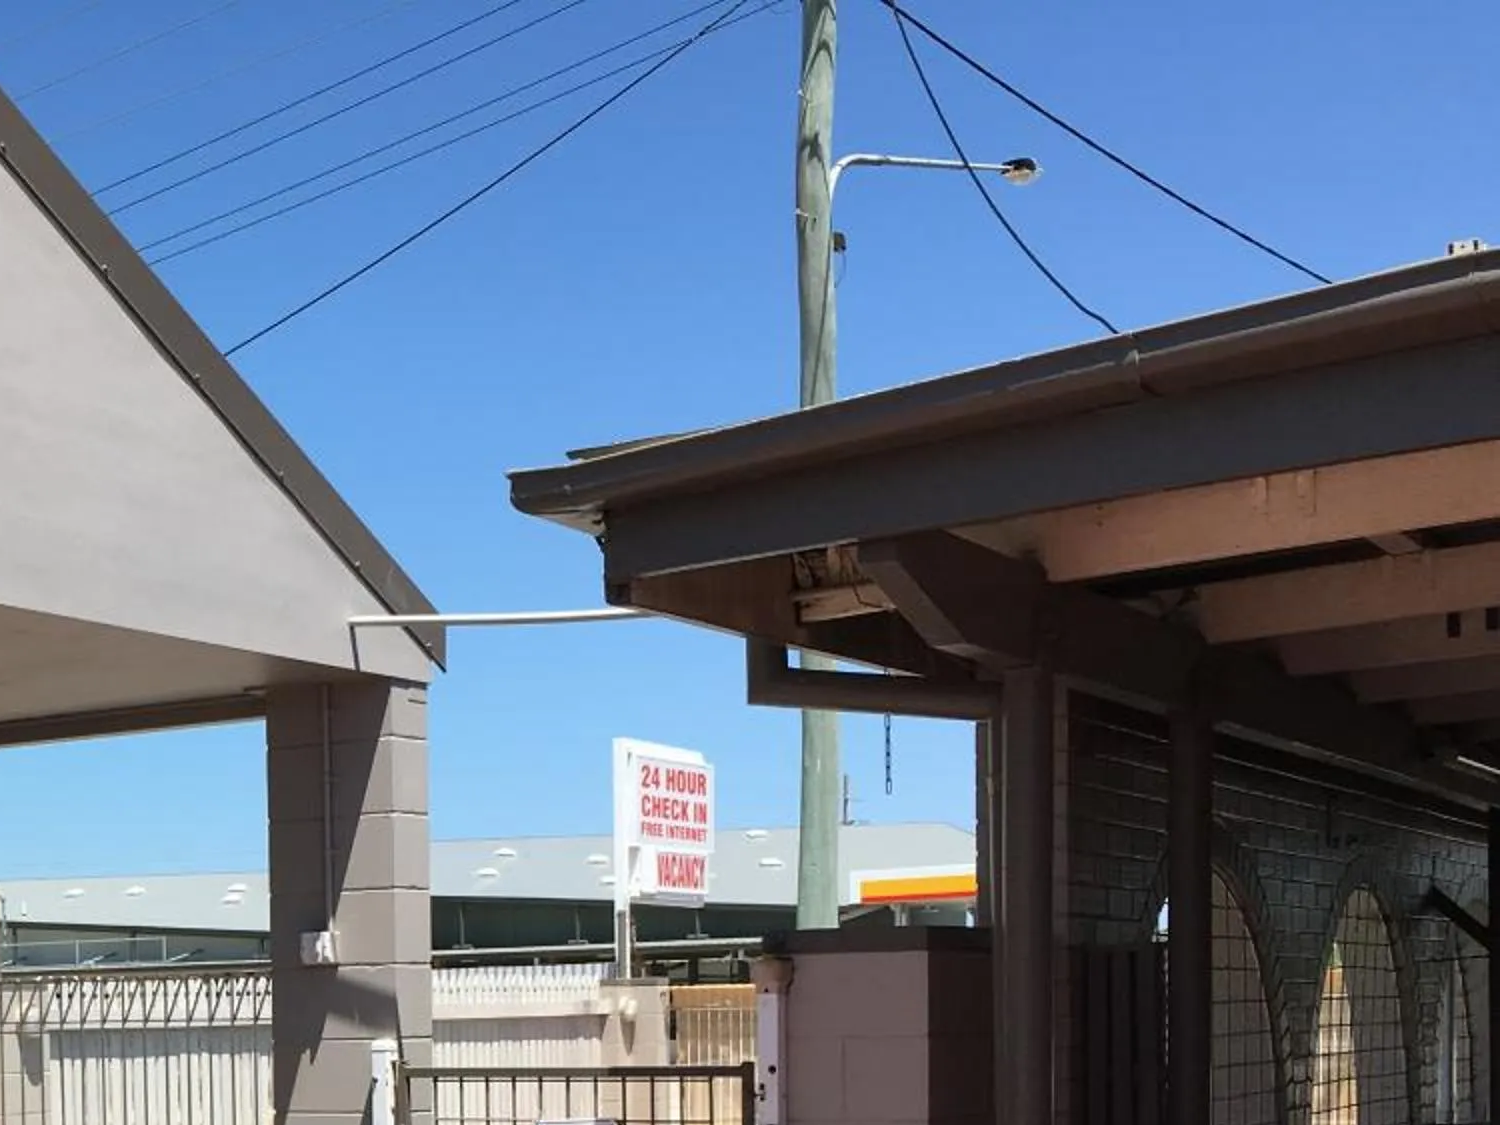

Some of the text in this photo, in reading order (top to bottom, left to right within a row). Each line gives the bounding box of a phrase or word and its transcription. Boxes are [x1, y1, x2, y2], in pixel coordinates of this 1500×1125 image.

[641, 764, 707, 796] 24 HOUR
[641, 795, 707, 824] CHECK IN
[641, 820, 708, 842] FREE INTERNET
[657, 853, 706, 889] VACANCY
